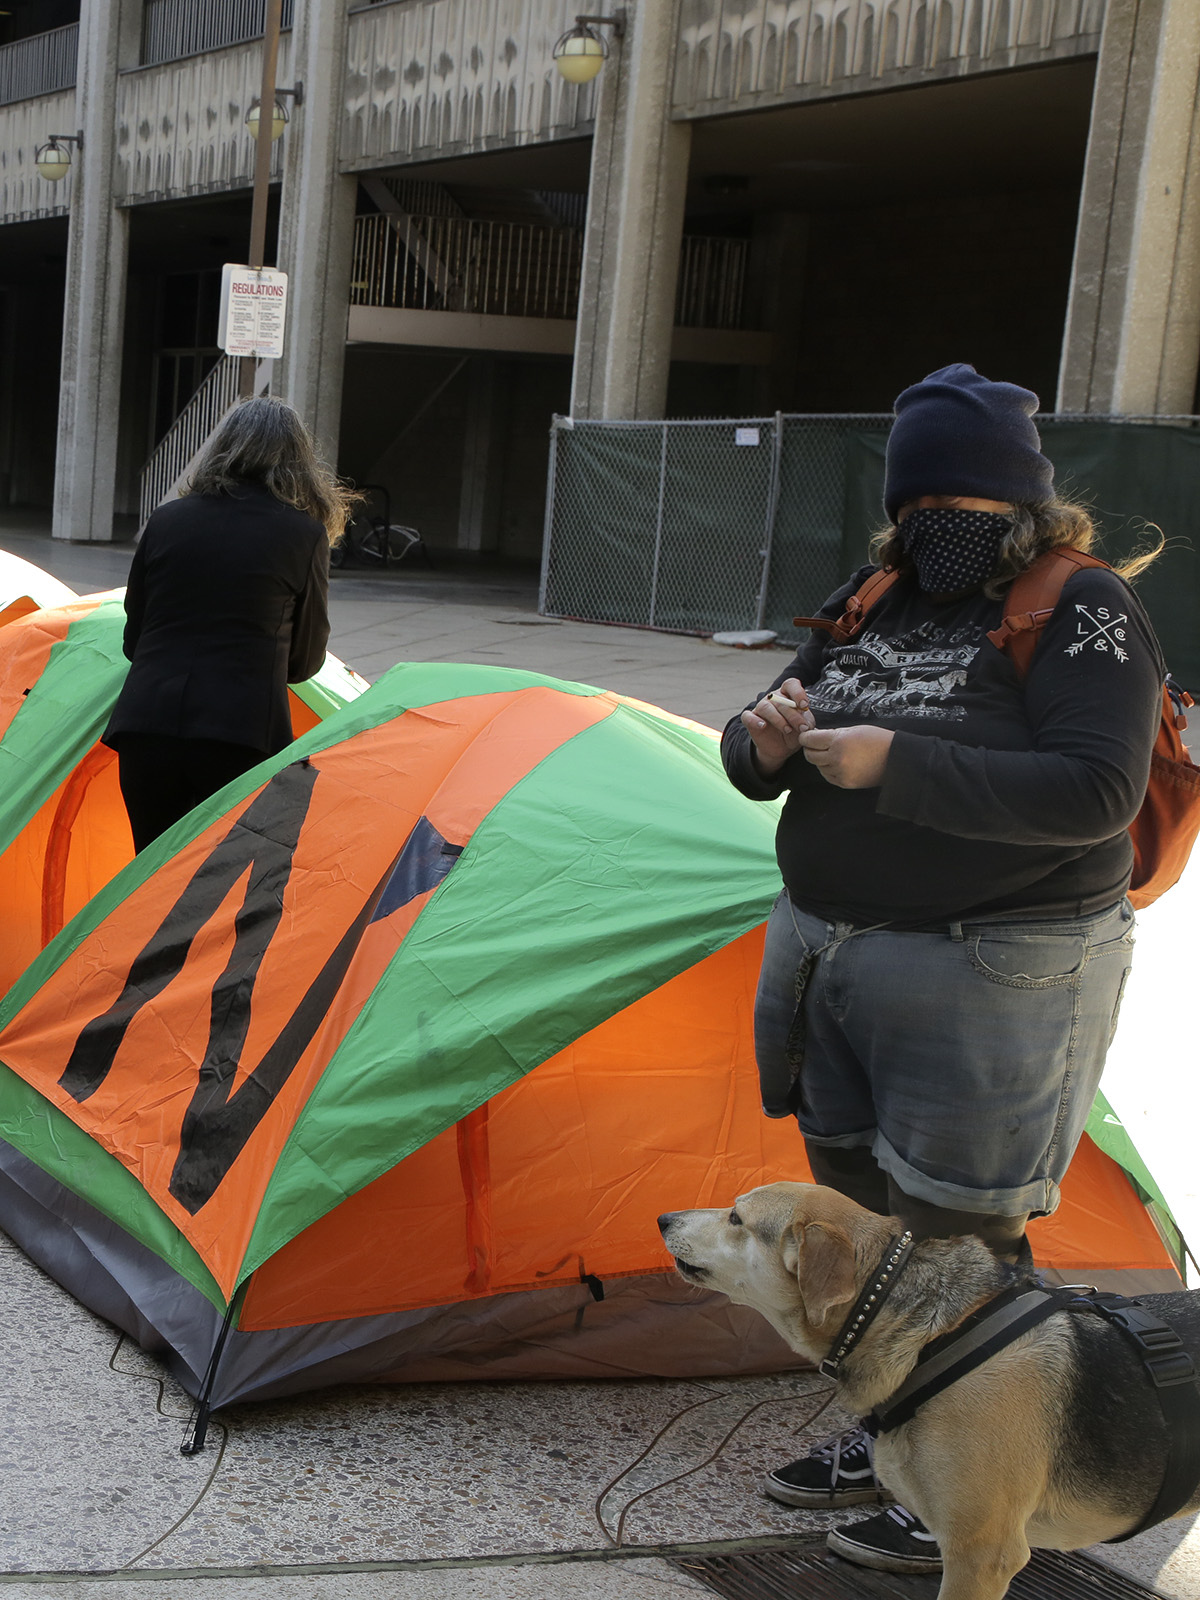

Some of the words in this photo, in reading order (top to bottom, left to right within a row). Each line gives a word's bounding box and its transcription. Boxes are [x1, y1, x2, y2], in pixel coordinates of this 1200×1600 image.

[232, 282, 284, 297] REGULATIONS
[1097, 607, 1110, 620] S
[1077, 622, 1089, 635] L
[896, 649, 968, 664] RIVETD
